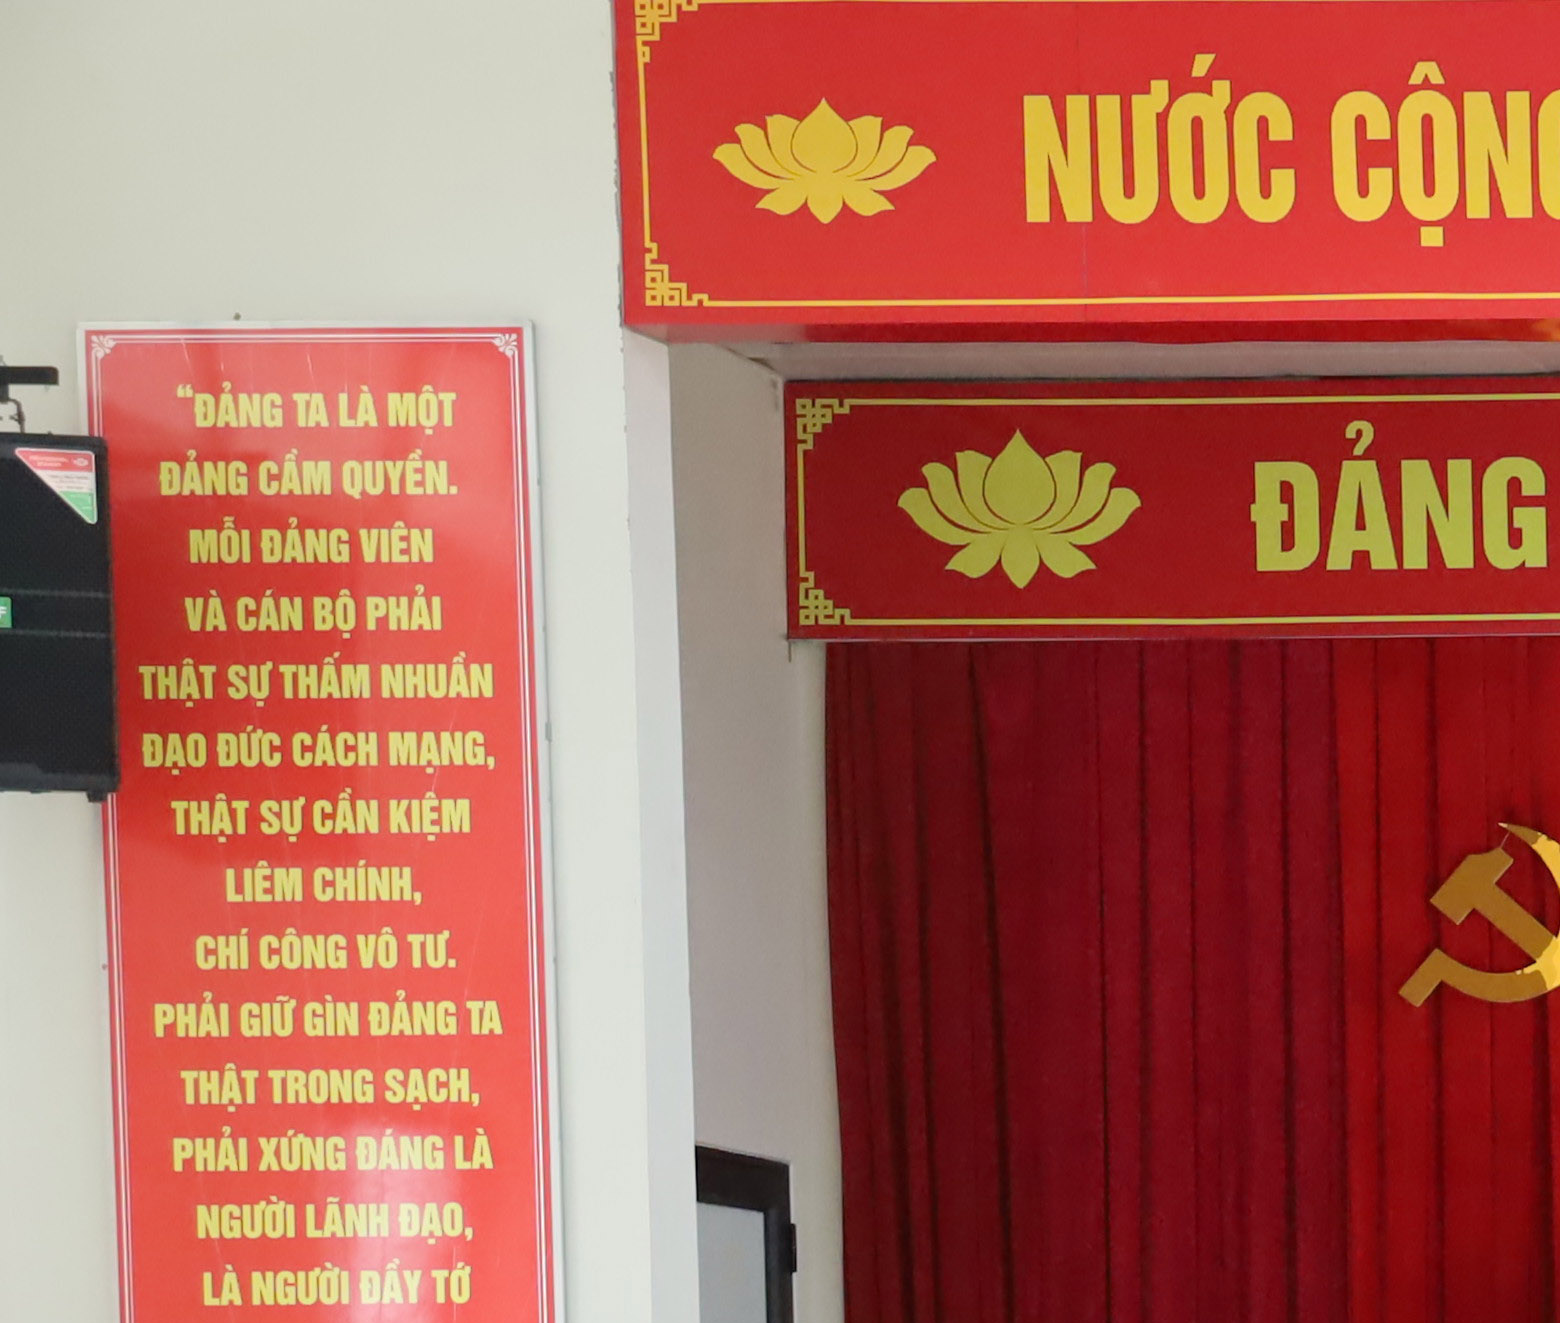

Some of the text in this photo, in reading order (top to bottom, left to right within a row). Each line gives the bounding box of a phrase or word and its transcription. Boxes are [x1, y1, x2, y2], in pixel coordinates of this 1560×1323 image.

[1024, 54, 1296, 223] NƯỚC
[292, 392, 329, 427] TA
[338, 385, 379, 427] LÀ
[386, 384, 457, 434] MỘT
[157, 449, 458, 498] ĐẢNG CẦM QUYỀN.
[1250, 421, 1547, 571] ĐẢNG
[188, 516, 434, 564] MỖI ĐẢNG VIÊN
[184, 584, 443, 638] VÀ CÁN BỘ PHẢI
[224, 860, 424, 904] LIÊM CHÍNH,
[194, 927, 456, 970] CHÍ CÔNG VÔ TƯ.
